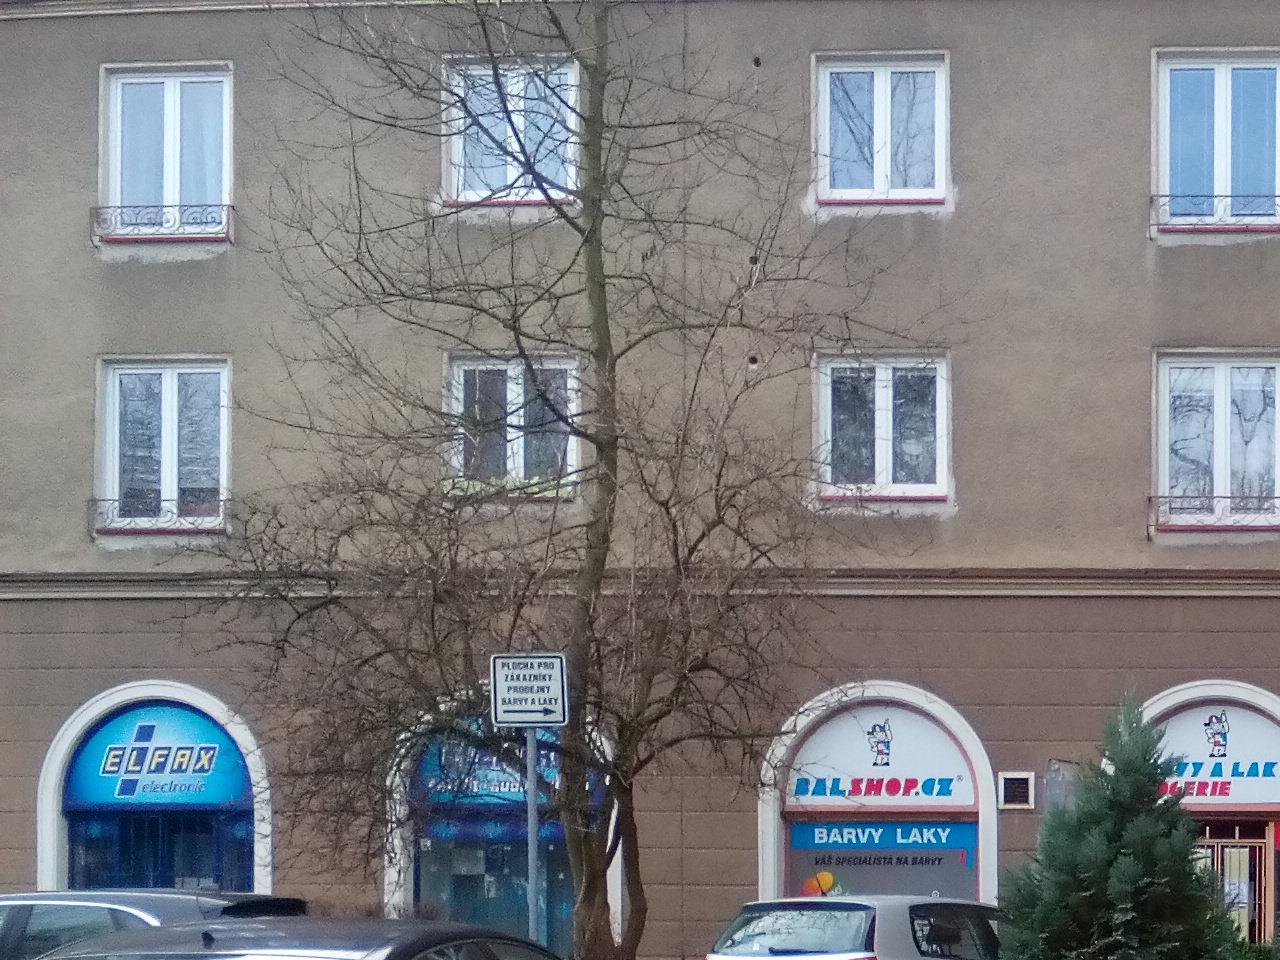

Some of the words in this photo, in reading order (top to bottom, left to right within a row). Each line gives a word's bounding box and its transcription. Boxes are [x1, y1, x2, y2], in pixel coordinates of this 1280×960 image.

[537, 661, 555, 670] PRO
[501, 697, 529, 706] BARVY
[530, 697, 537, 706] A
[102, 747, 216, 774] ELFAX
[1209, 761, 1224, 778] A
[141, 780, 206, 793] electronic
[814, 828, 884, 844] BARVY
[896, 828, 951, 844] LAKY
[835, 856, 893, 867] SPECIALISTA
[895, 856, 909, 866] NA
